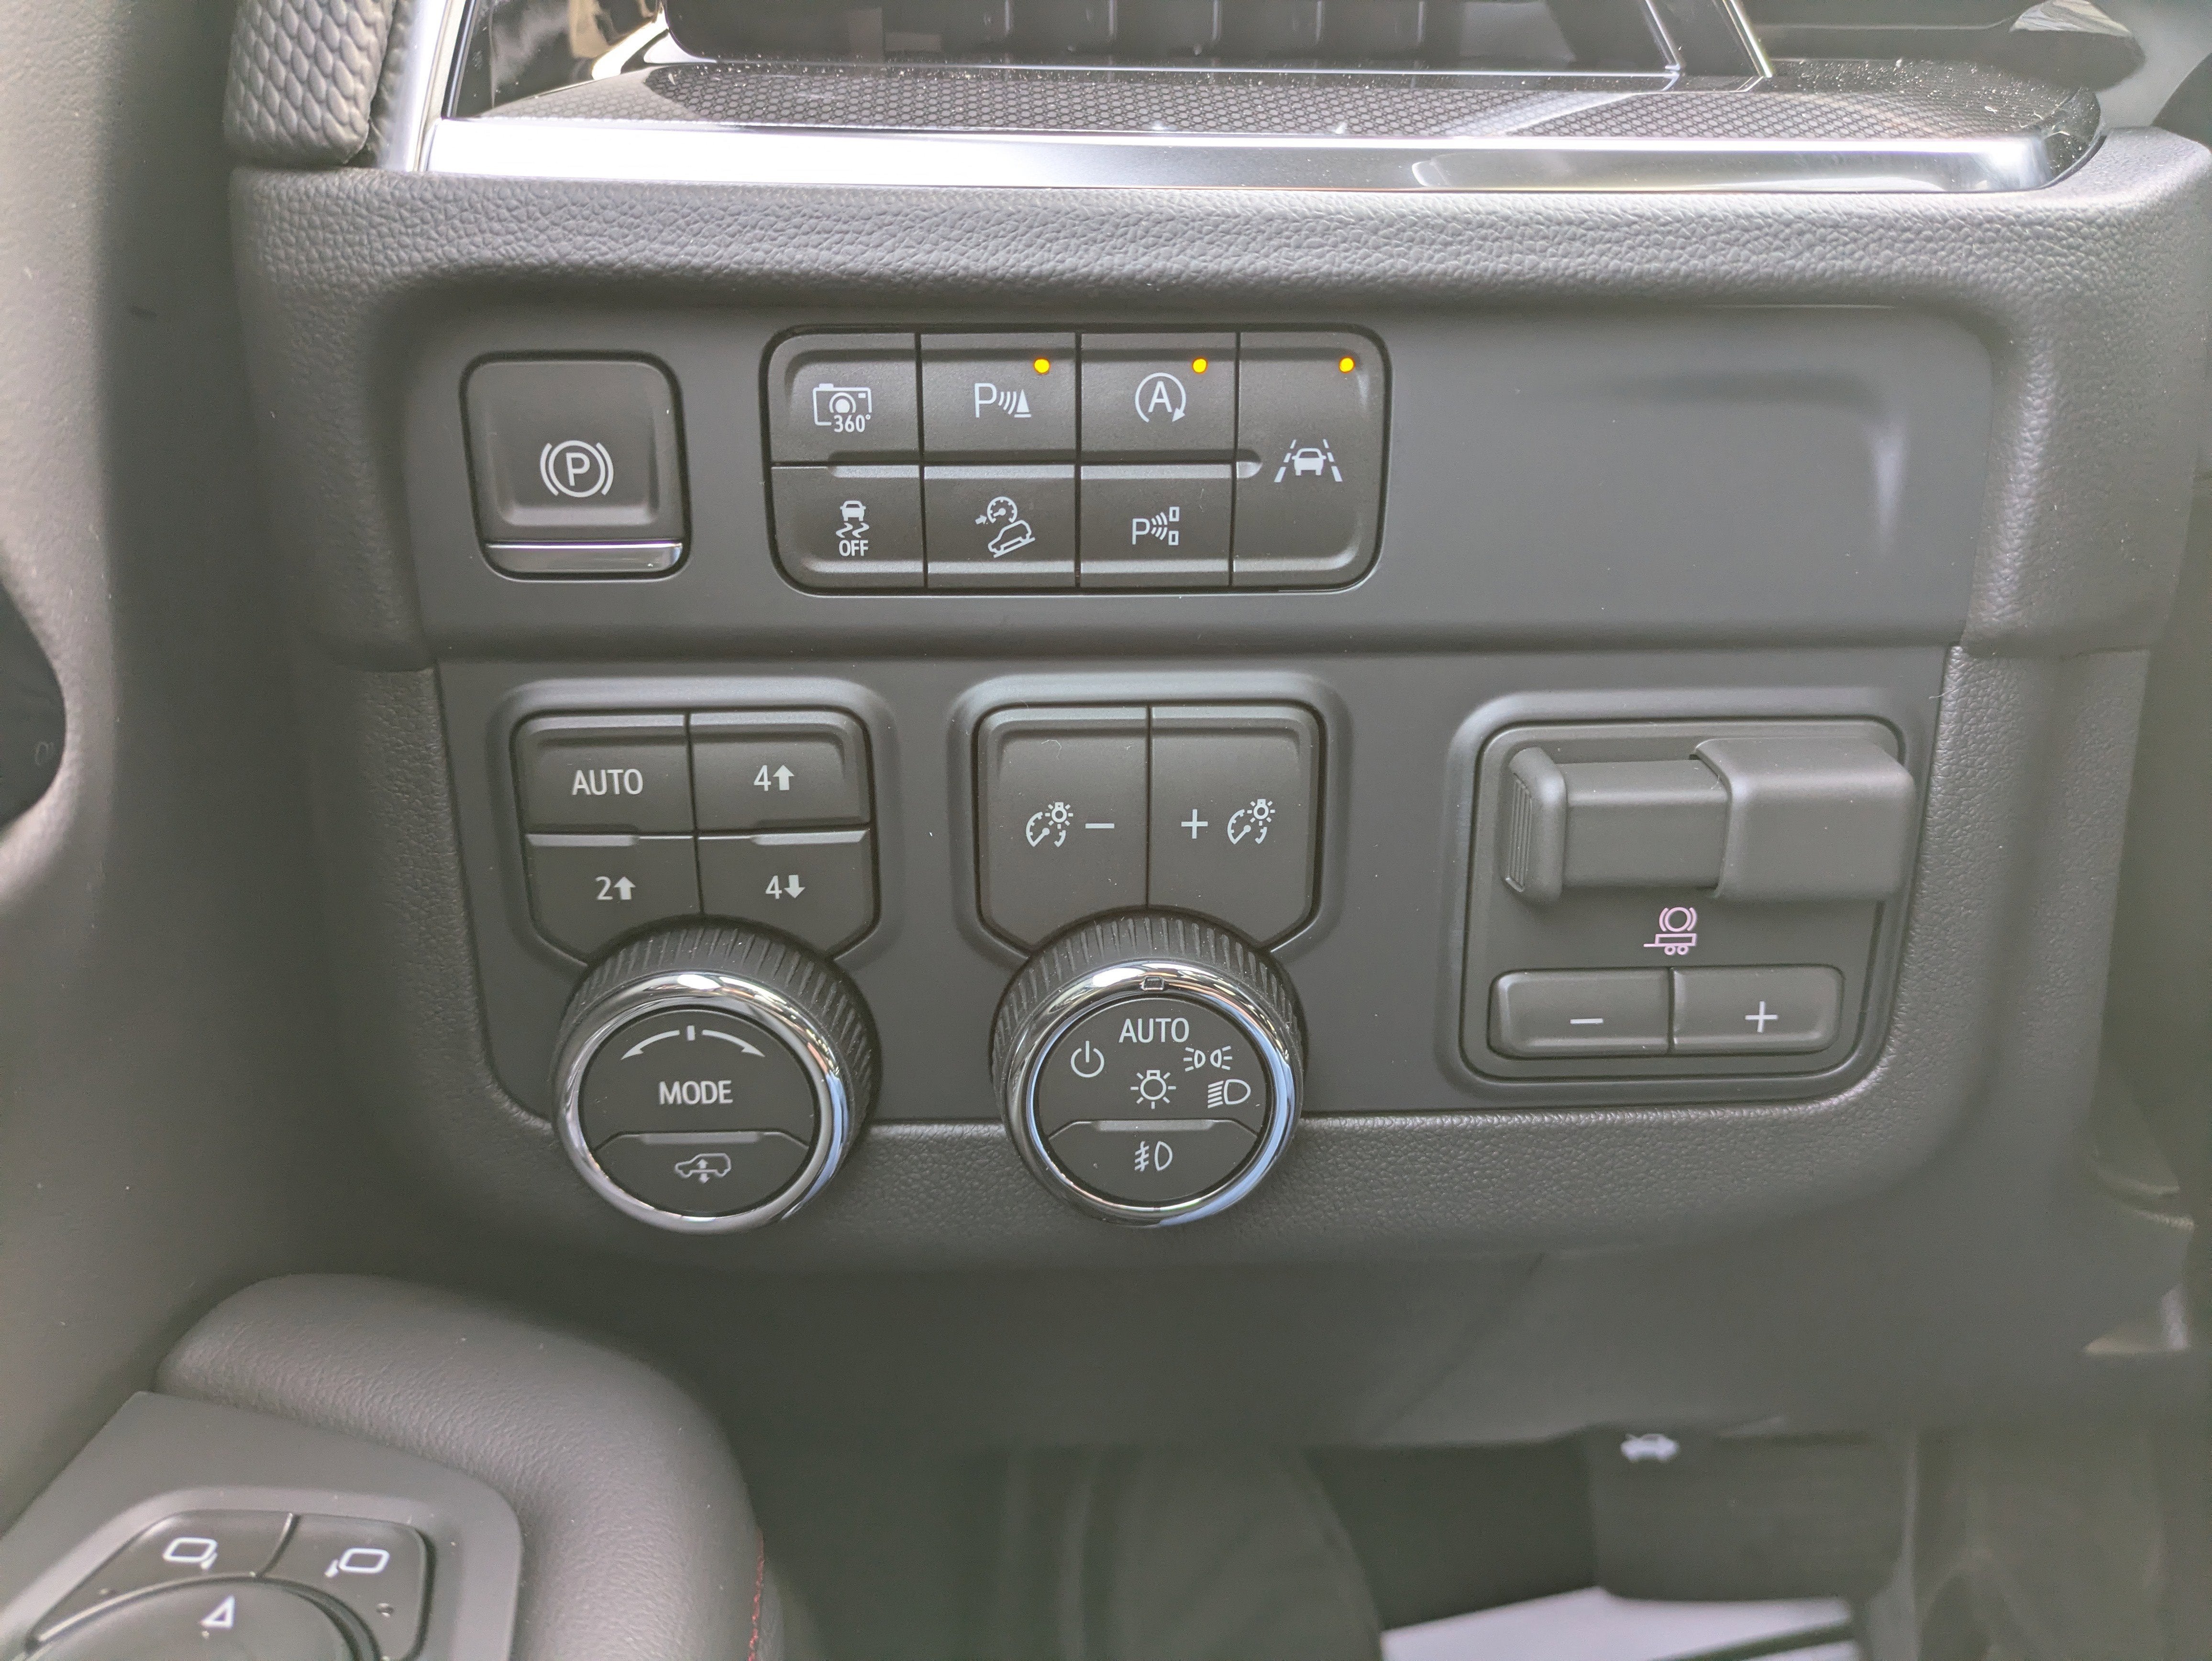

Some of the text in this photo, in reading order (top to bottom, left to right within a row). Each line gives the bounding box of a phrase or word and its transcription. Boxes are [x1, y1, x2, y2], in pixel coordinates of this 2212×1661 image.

[974, 382, 997, 418] P
[565, 452, 590, 487] P
[1132, 518, 1150, 545] P
[839, 539, 869, 557] OFF
[572, 768, 644, 796] AUTO
[753, 764, 772, 792] 4
[596, 875, 614, 900] 2
[765, 875, 783, 899] 4
[1118, 1017, 1190, 1044] AUTO
[659, 1080, 734, 1105] MODE
